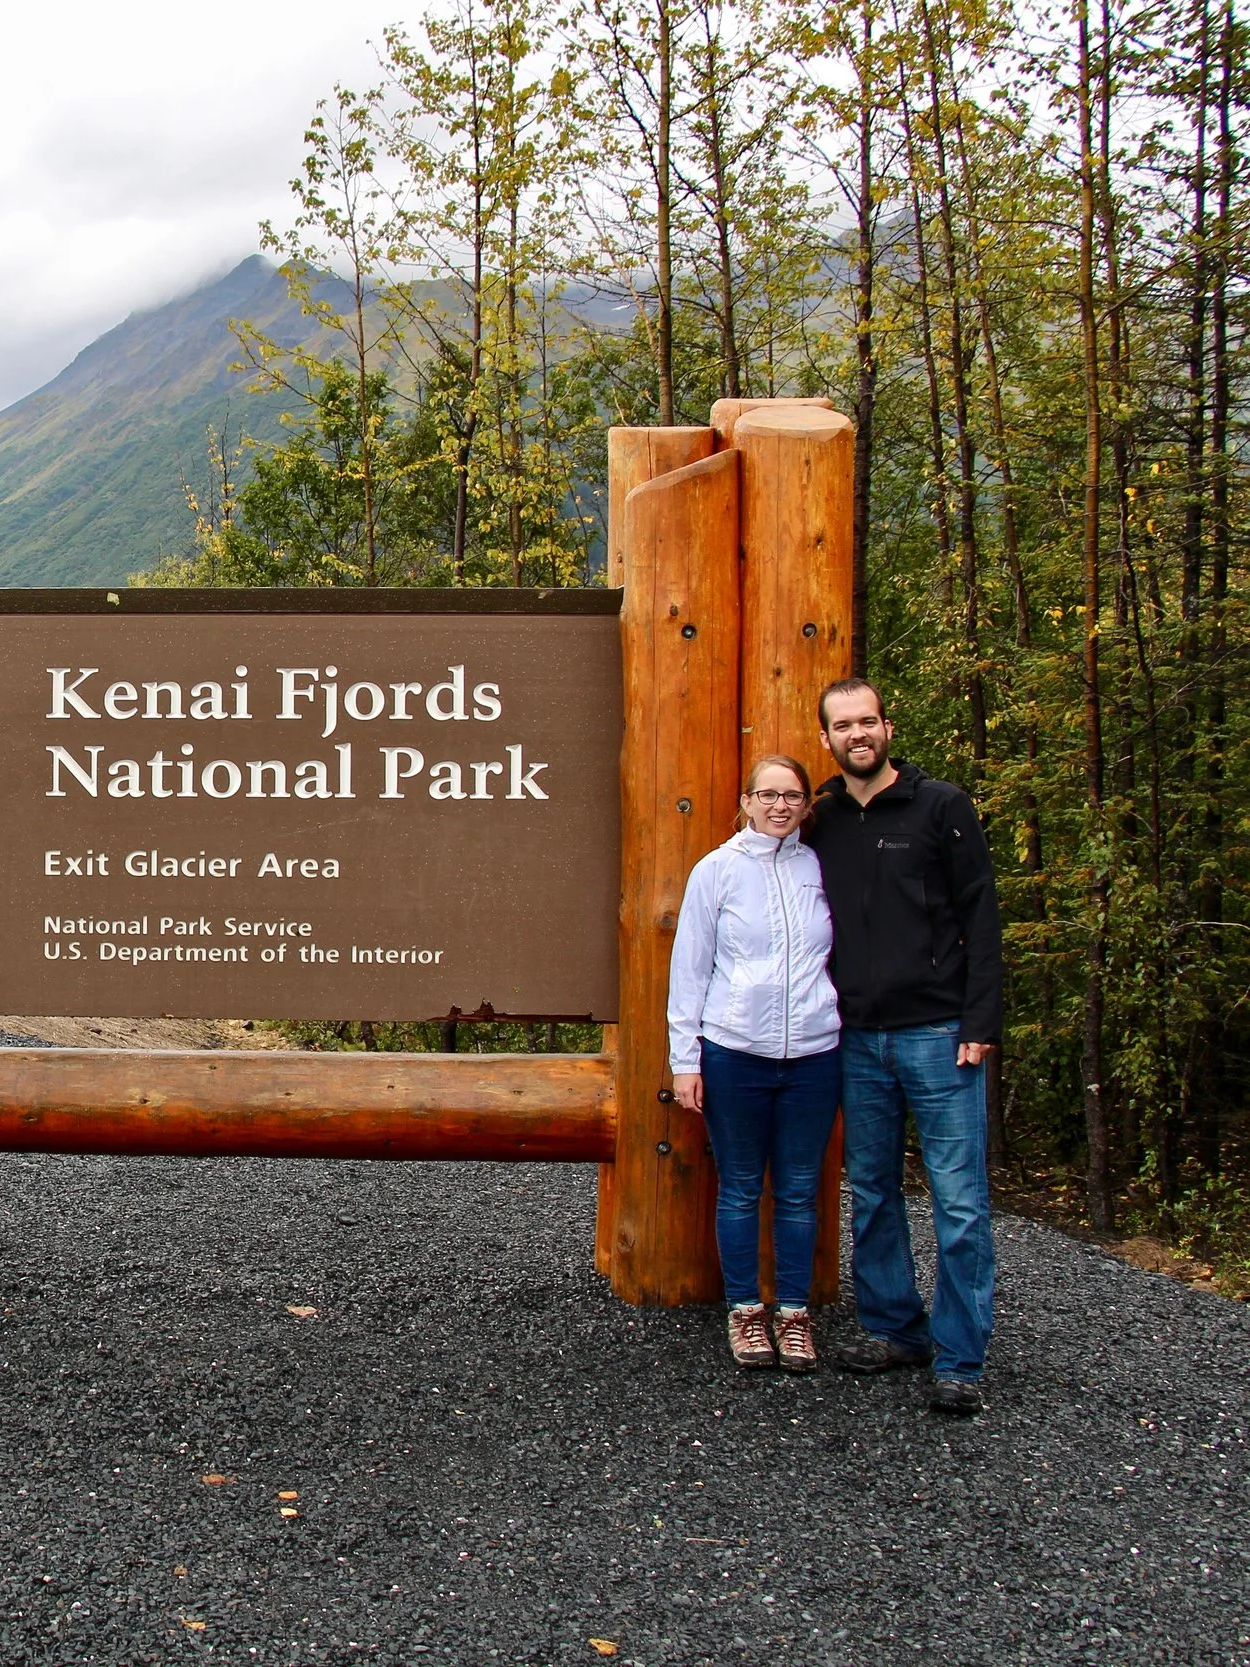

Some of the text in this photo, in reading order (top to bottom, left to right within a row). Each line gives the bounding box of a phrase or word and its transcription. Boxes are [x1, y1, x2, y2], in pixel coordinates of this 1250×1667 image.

[45, 664, 503, 738] Kenai Fjords
[45, 743, 550, 800] National Park
[44, 850, 340, 878] Exit Glacier Area
[44, 915, 313, 937] National Park Service
[44, 942, 444, 966] U.S. Department of the Interior
